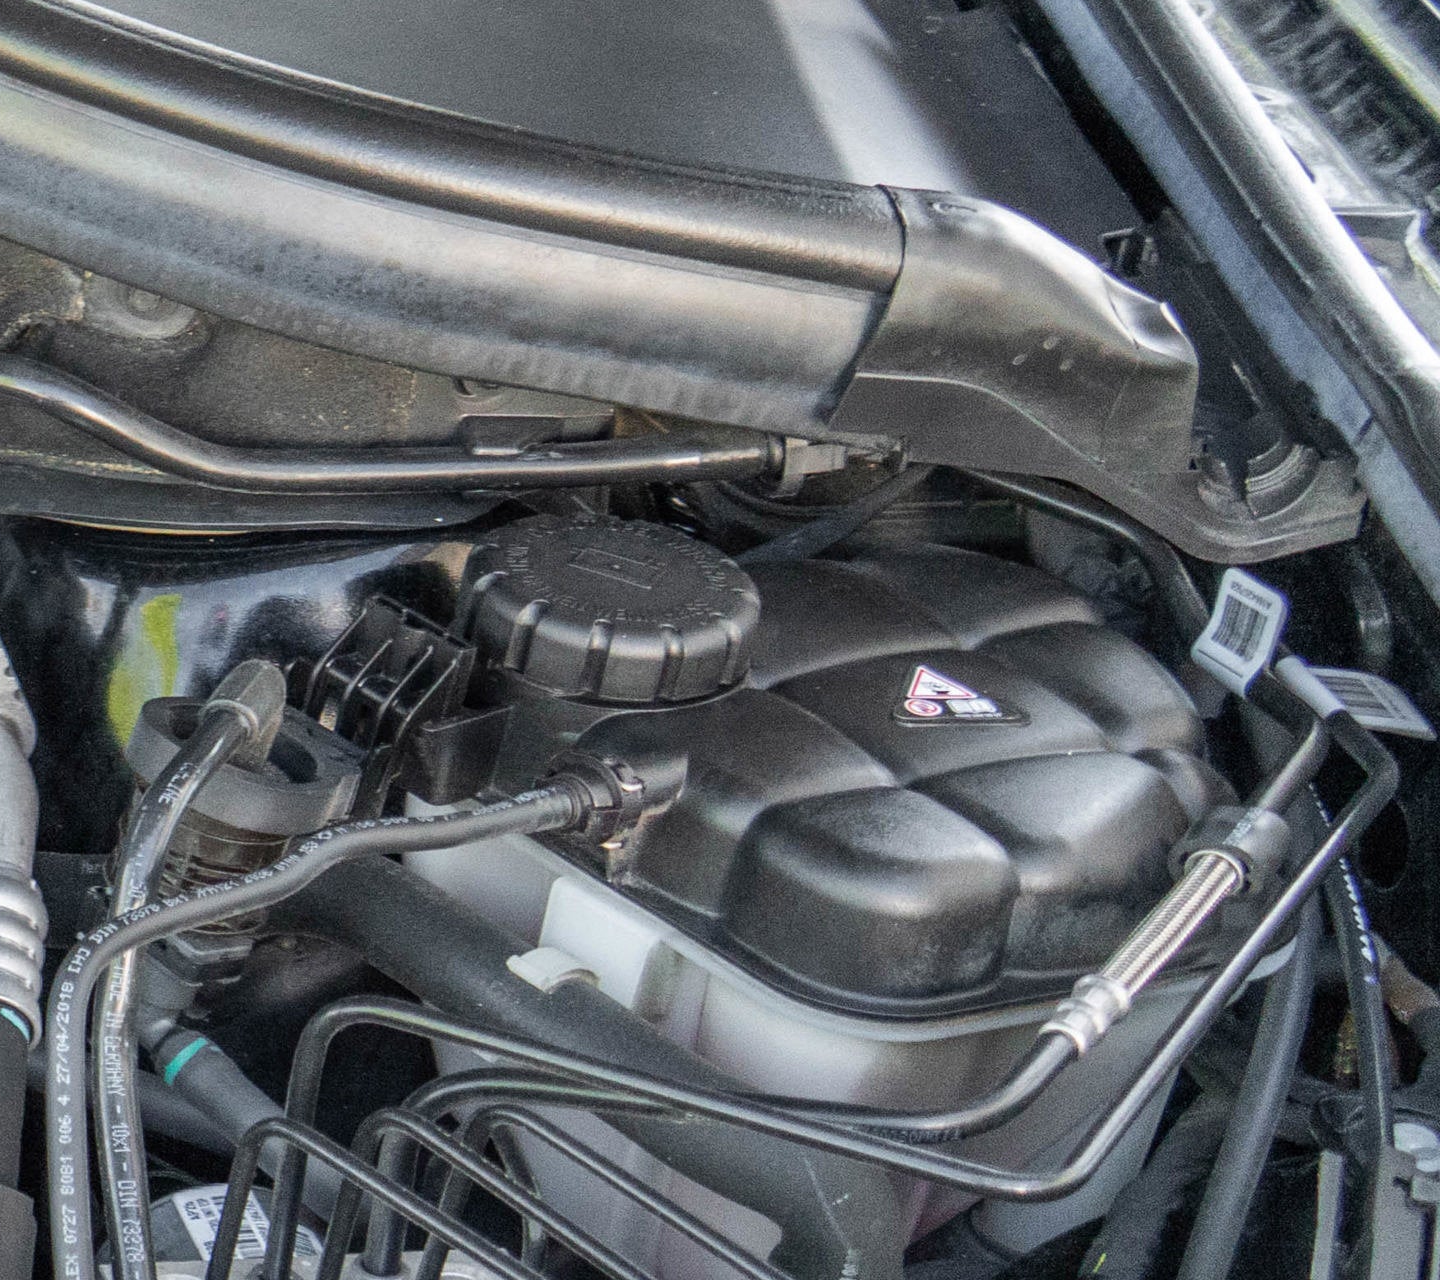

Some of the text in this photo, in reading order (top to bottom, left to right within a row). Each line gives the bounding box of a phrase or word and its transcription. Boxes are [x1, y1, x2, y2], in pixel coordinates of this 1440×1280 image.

[56, 981, 74, 1083] 27/04/2018
[105, 1011, 125, 1029] IN
[104, 1036, 126, 1096] GERMANY
[117, 1180, 137, 1208] DIN
[62, 1205, 77, 1243] 0727
